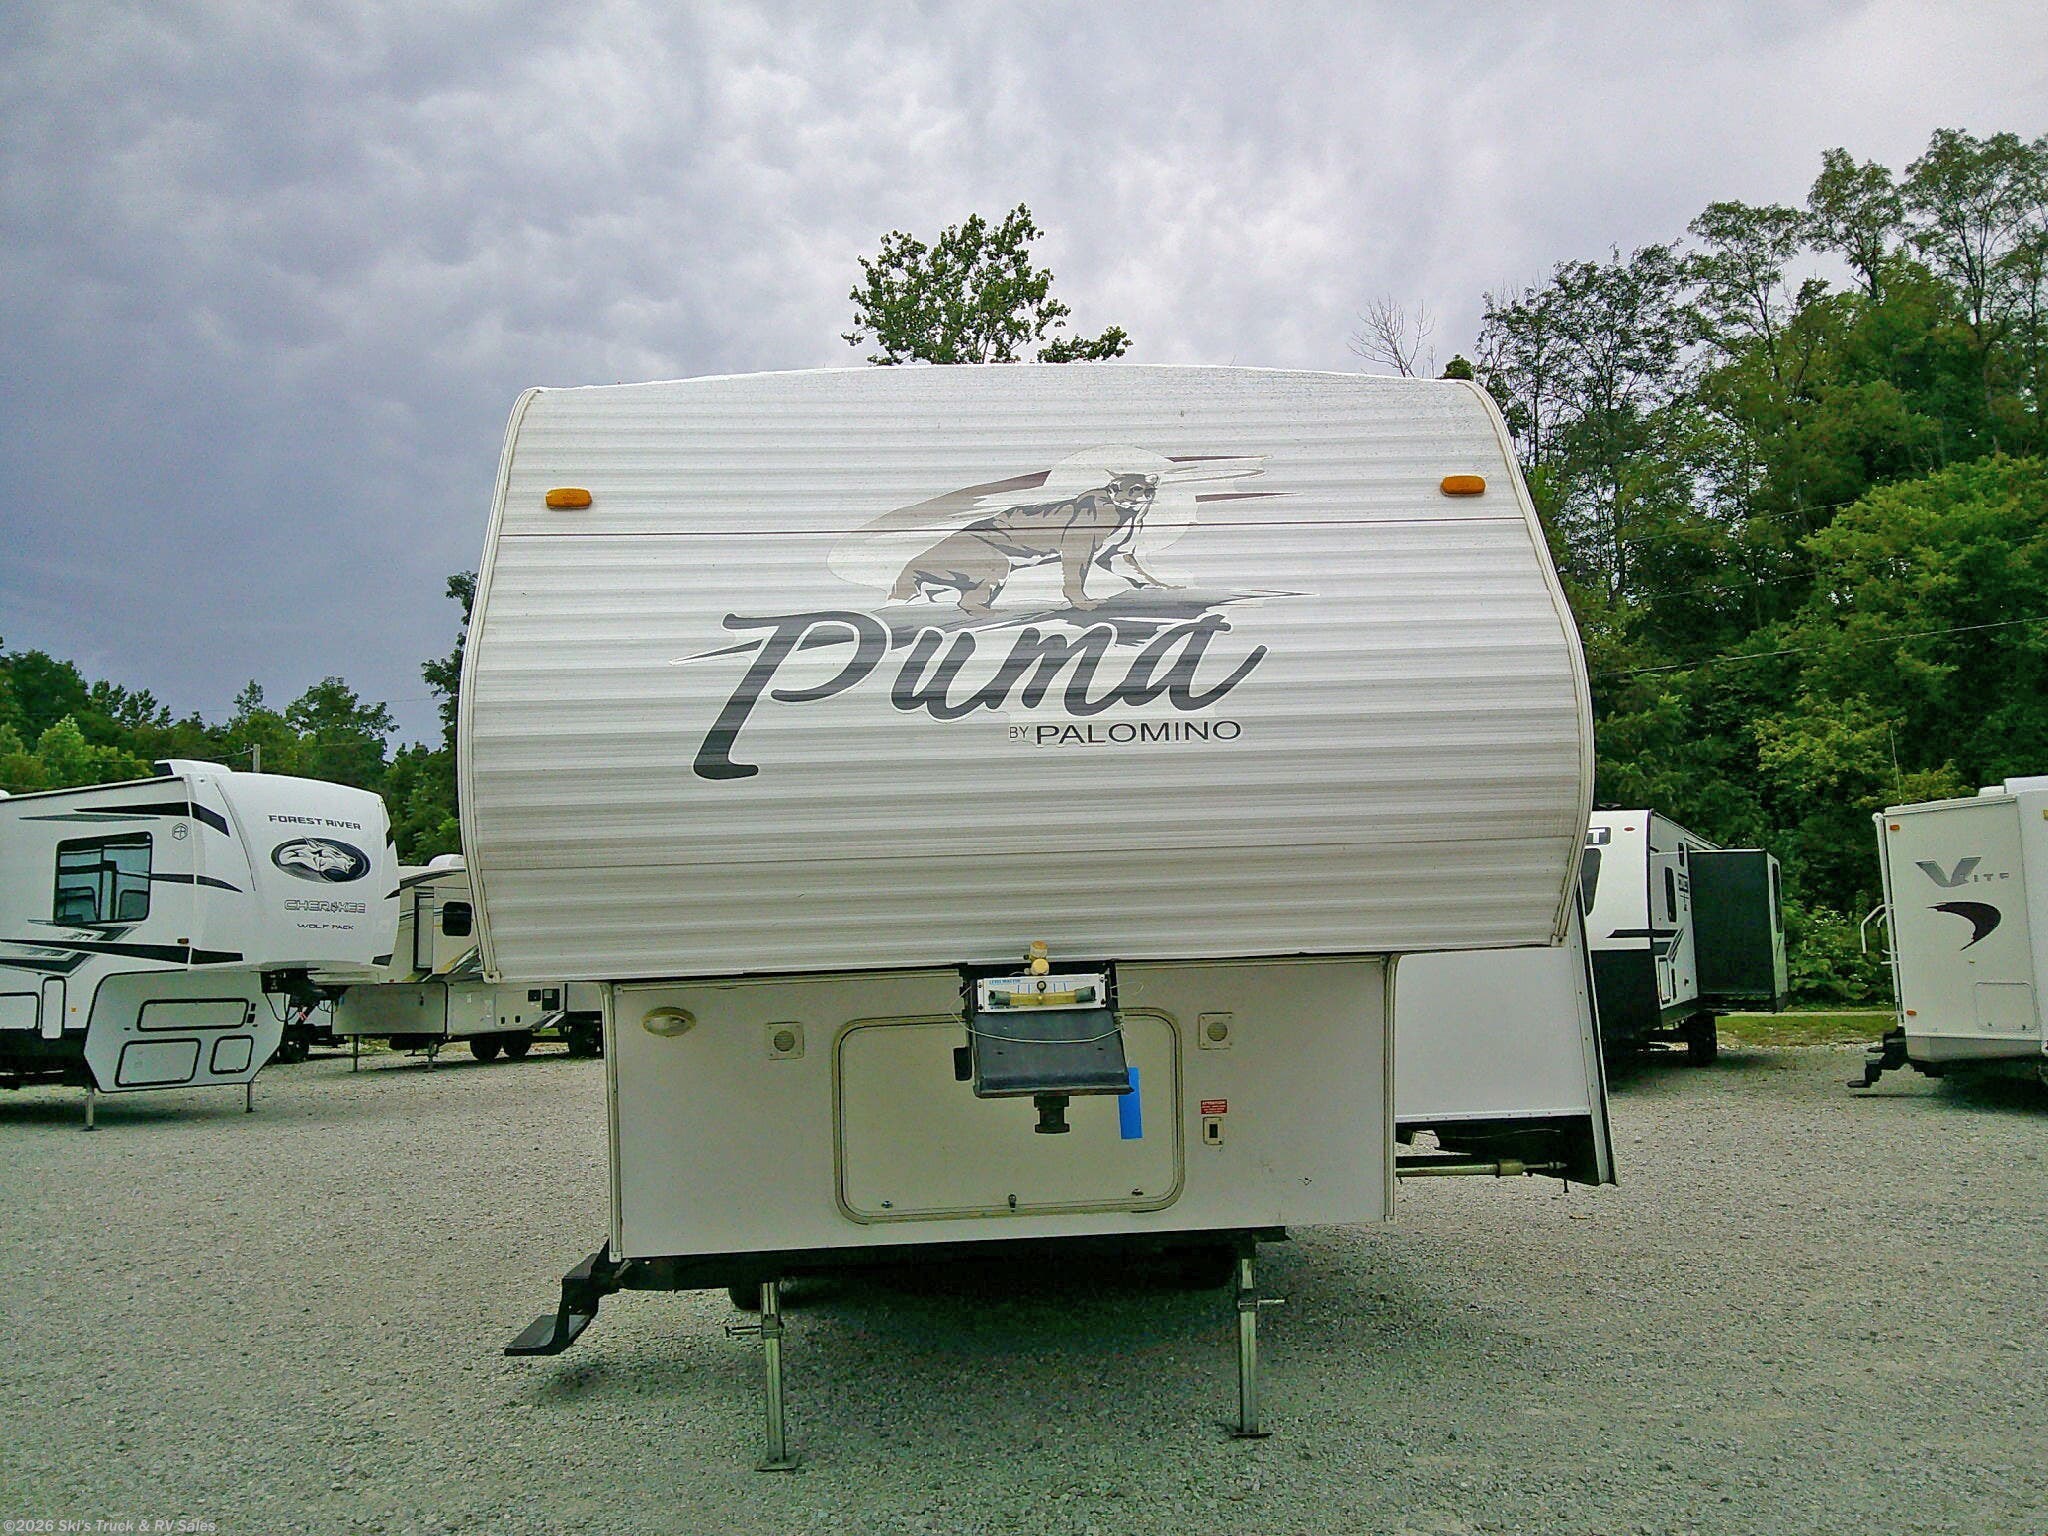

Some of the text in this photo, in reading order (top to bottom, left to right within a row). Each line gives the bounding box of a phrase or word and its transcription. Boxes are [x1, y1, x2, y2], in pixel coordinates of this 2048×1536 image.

[694, 611, 1267, 779] Puma
[1009, 720, 1242, 745] BY PALOMINO
[268, 815, 322, 826] FOREST
